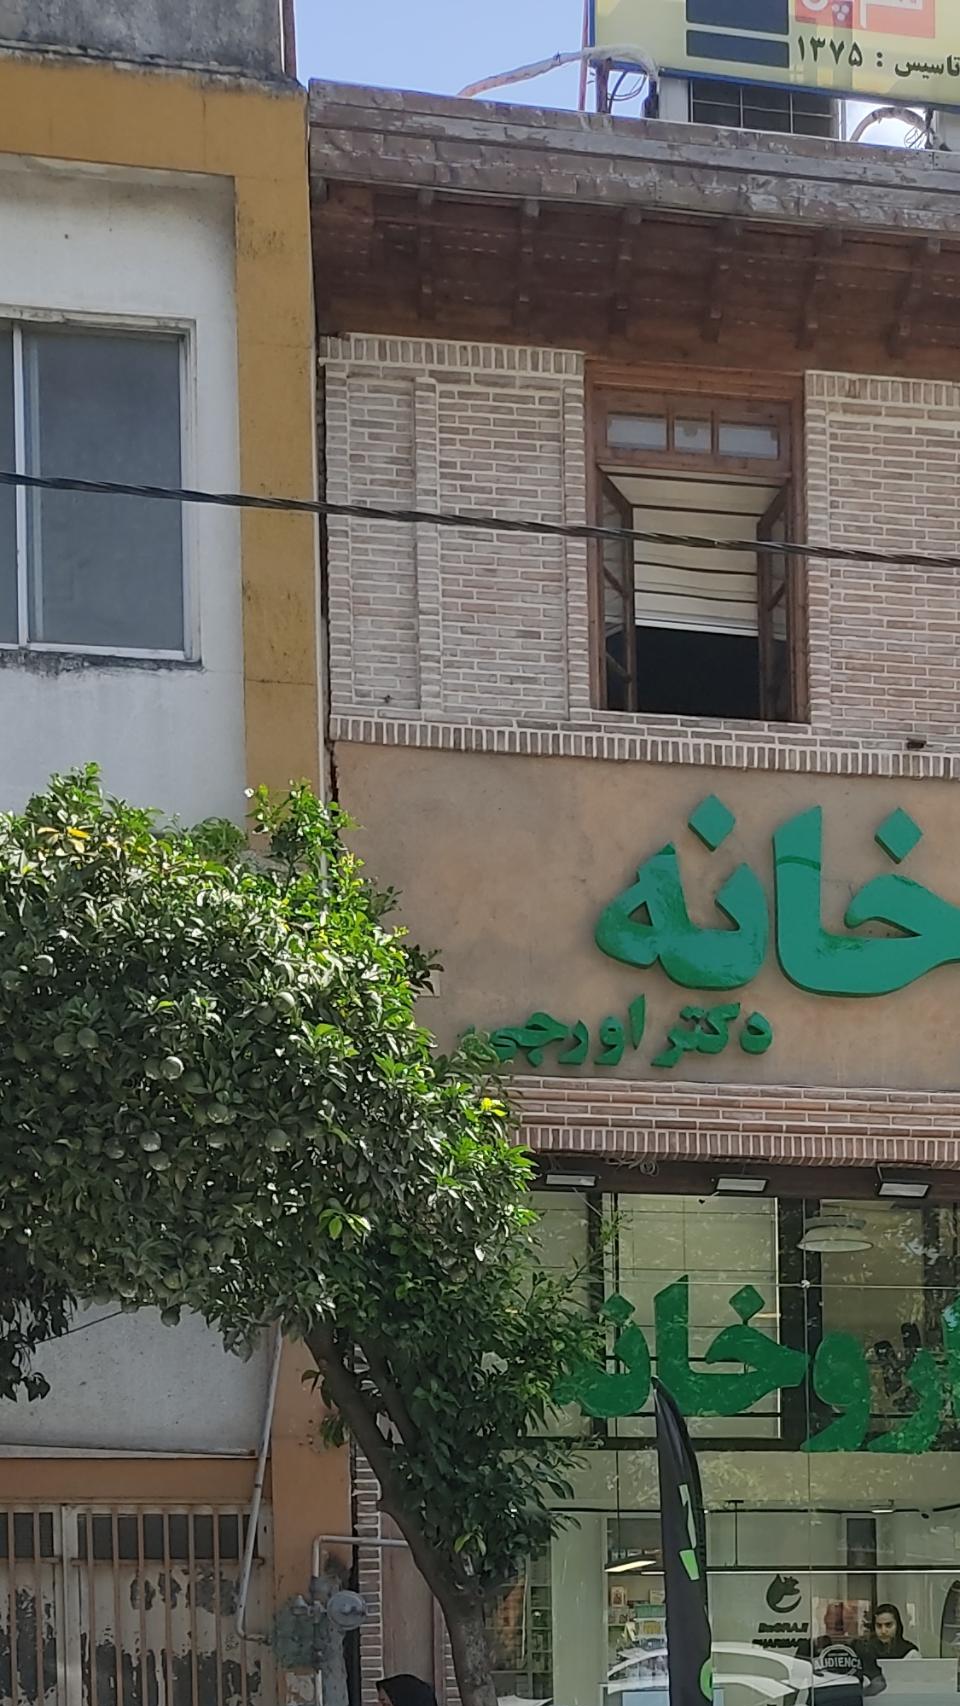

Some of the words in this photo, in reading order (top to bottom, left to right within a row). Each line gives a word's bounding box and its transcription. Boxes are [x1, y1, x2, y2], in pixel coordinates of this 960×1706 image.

[797, 36, 864, 67] ۱۳۷۵
[894, 54, 960, 80] تاسیس
[652, 1002, 773, 1068] دکتر
